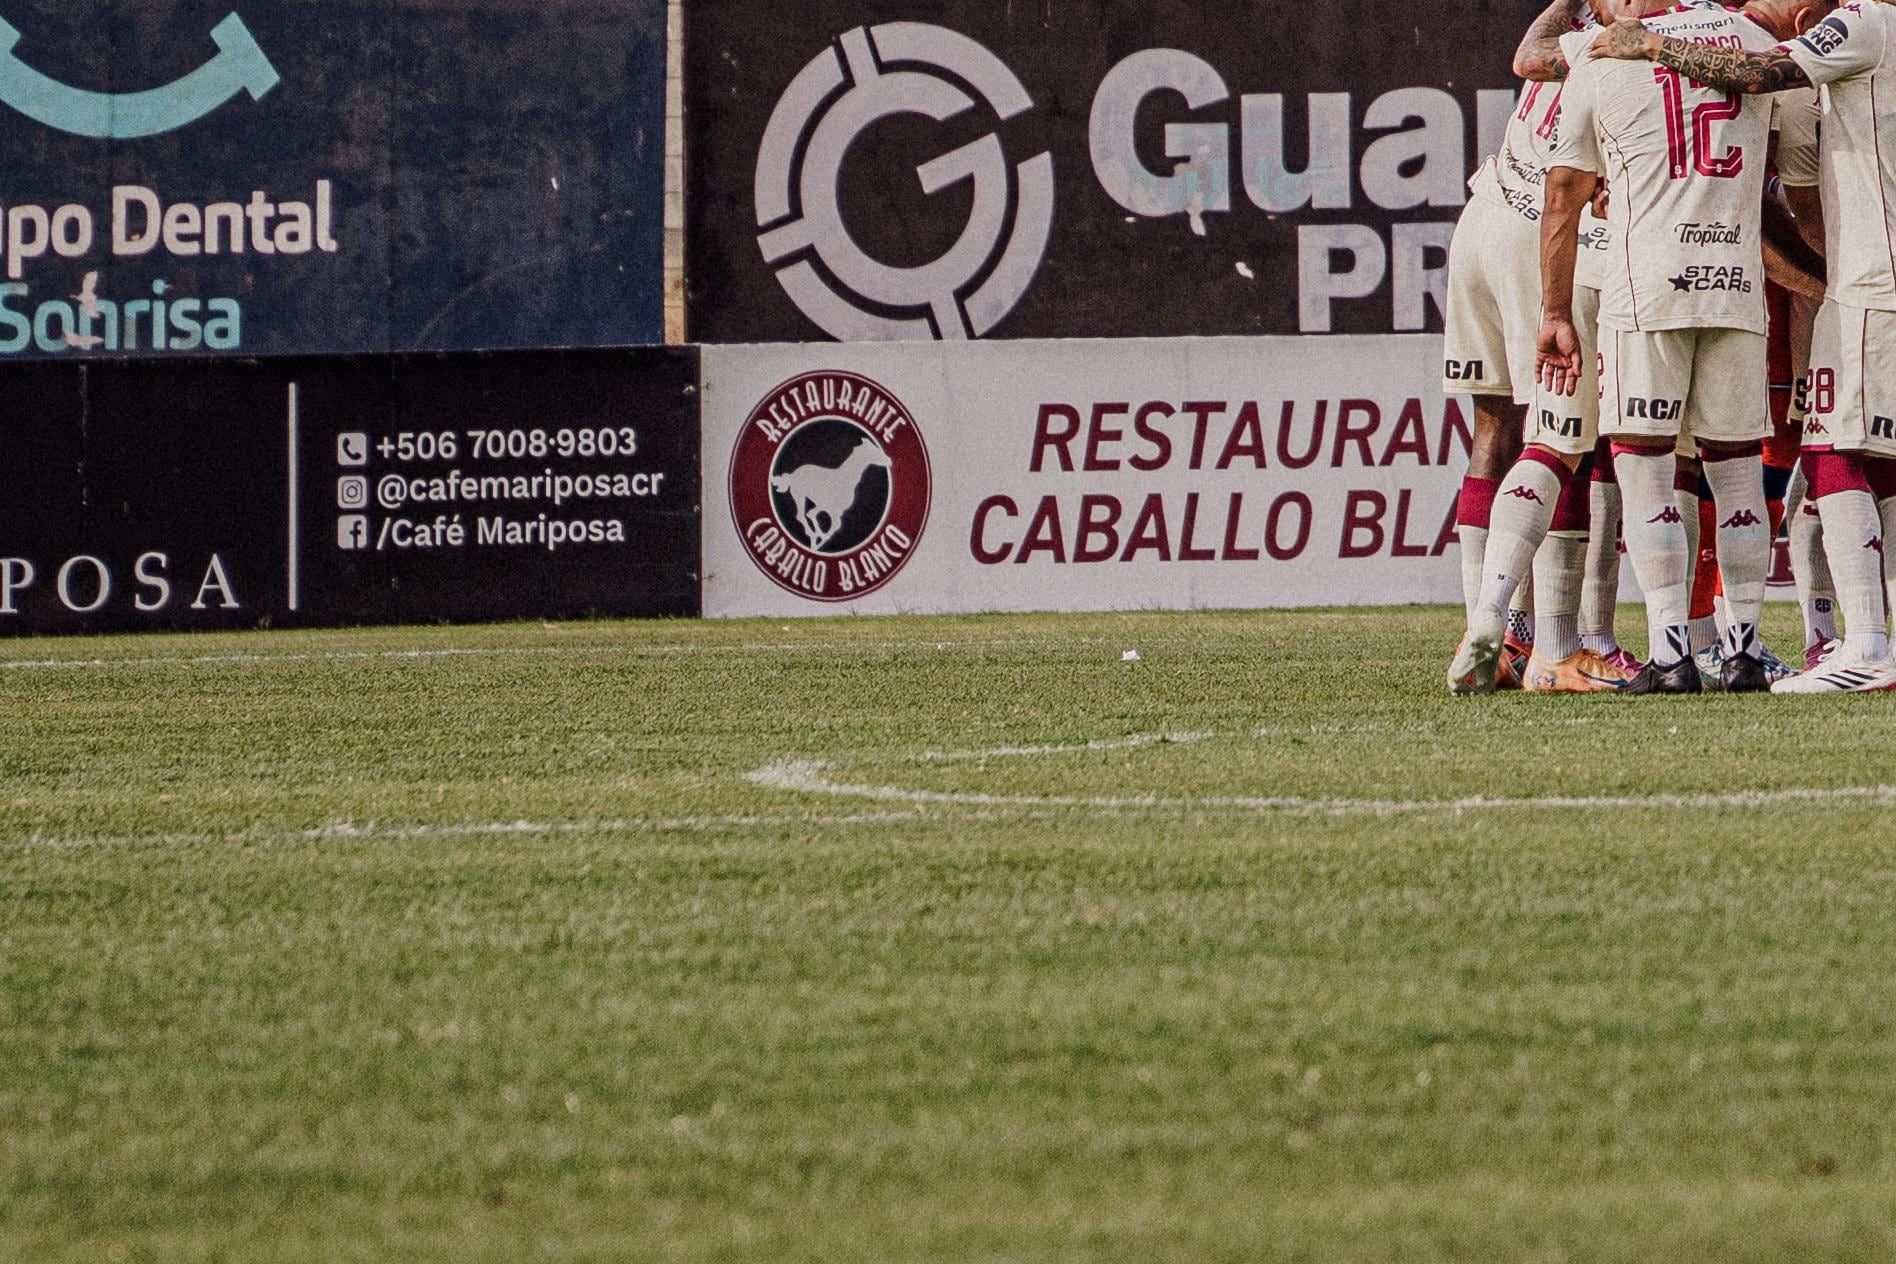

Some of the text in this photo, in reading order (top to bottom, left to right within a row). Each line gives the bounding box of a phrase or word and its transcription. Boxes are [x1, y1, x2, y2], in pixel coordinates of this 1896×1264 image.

[1654, 67, 1743, 179] 12
[0, 179, 338, 279] po Dental
[1674, 221, 1742, 247] Tropical
[1298, 222, 1452, 333] PR
[1684, 265, 1744, 280] STAR
[1694, 277, 1752, 293] CARS
[0, 279, 241, 353] Sonrisa
[756, 378, 907, 443] RESTAURANTE
[1626, 396, 1683, 420] RCA
[376, 432, 457, 461] +506
[377, 468, 664, 509] @cafemariposacr
[376, 513, 625, 551] /Café Mariposa
[747, 517, 911, 593] CABALLO BLANCO
[970, 491, 1313, 565] CABALLO
[0, 552, 240, 614] POSA
